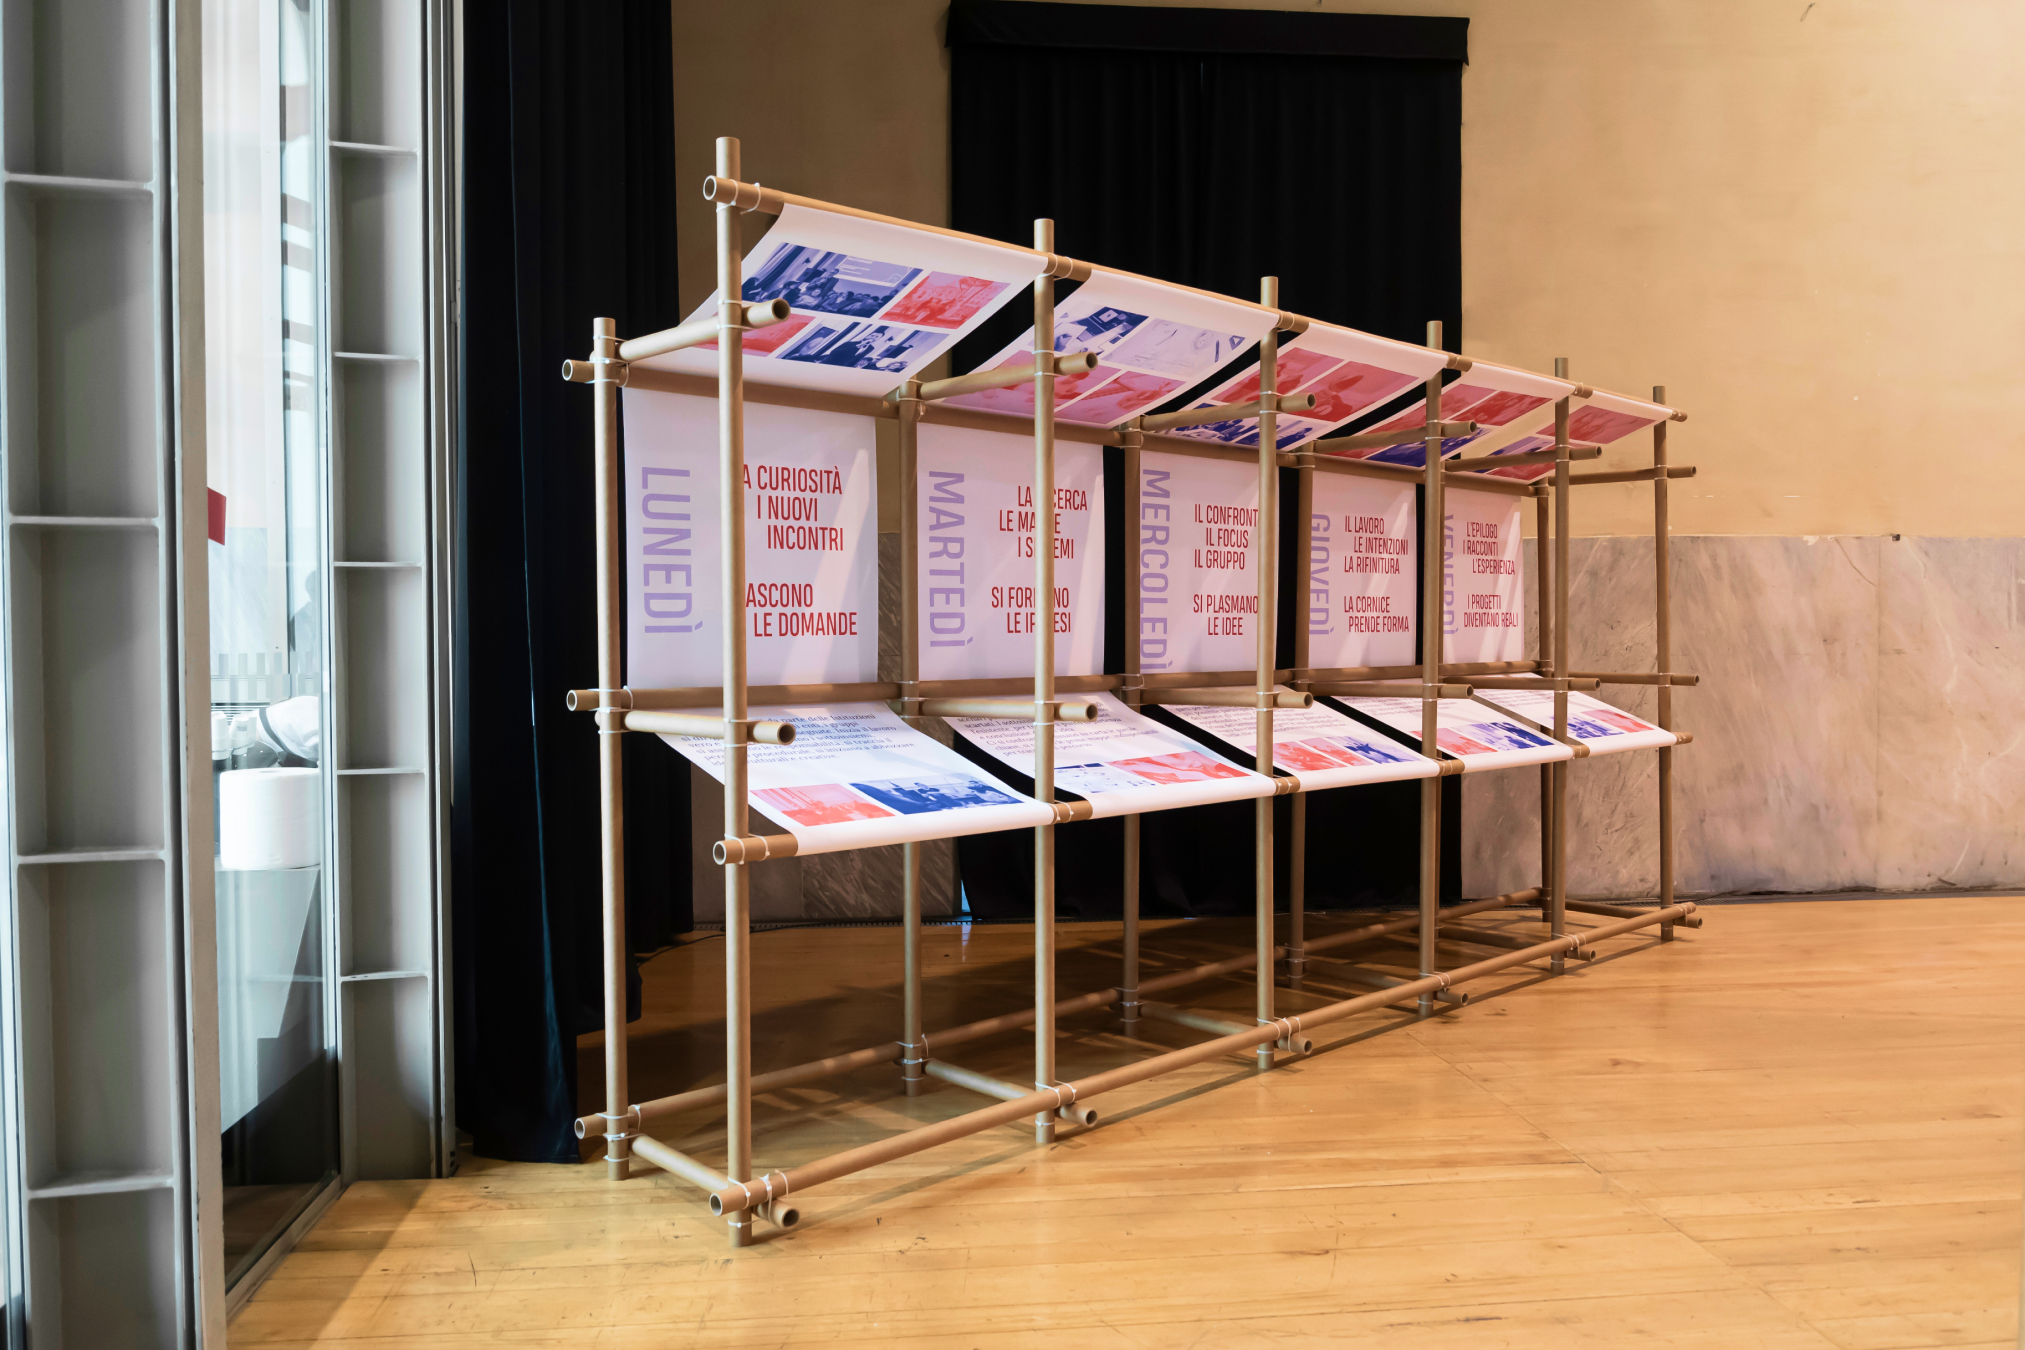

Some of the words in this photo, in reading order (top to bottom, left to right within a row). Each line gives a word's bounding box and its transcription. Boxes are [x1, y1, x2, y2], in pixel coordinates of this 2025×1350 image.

[744, 464, 752, 490] A
[758, 465, 842, 495] CURIOSITÀ
[757, 494, 761, 519] I
[768, 495, 818, 522] NUOVI
[1018, 486, 1032, 508] LA
[1000, 510, 1014, 532] LE
[1018, 511, 1061, 534] MAE
[1194, 504, 1203, 524] IL
[1206, 505, 1258, 528] CONFRONT
[1345, 515, 1352, 533] IL
[1354, 516, 1384, 535] LAVORO
[767, 525, 844, 551] INCONTRI
[1206, 528, 1214, 547] IL
[1218, 529, 1248, 548] FOCUS
[1466, 522, 1498, 539] L'EPILOGO
[642, 466, 703, 634] LUNEDÌ
[1018, 536, 1022, 558] I
[1354, 536, 1363, 553] LE
[1366, 538, 1408, 556] INTENZIONI
[1462, 540, 1465, 554] I
[1467, 540, 1498, 557] RACCONTI
[928, 470, 974, 648] MARTEDÌ
[1140, 469, 1173, 670] MERCOLEDÌ
[1194, 550, 1203, 568] IL
[1206, 550, 1245, 570] GRUPPO
[1344, 556, 1354, 573] LA
[1356, 557, 1400, 575] RIFINITURA
[1472, 558, 1515, 575] L'ESPERIENZA
[1309, 514, 1334, 635] GIOVEDÌ
[746, 582, 814, 608] ASCONO
[991, 586, 1004, 608] SI
[1194, 594, 1203, 614] SI
[1206, 595, 1258, 614] PLASMANO
[1344, 596, 1354, 612] LA
[1356, 596, 1390, 613] CORNICE
[1468, 594, 1470, 609] I
[1471, 594, 1501, 610] PROGETTI
[754, 612, 772, 637] LE
[778, 612, 858, 637] DOMANDE
[1007, 612, 1021, 634] LE
[1208, 617, 1218, 636] LE
[1222, 617, 1243, 636] IDEE
[1348, 616, 1380, 632] PRENDE
[1382, 616, 1409, 632] FORMA
[1464, 613, 1499, 628] DIVENTANO
[1502, 613, 1518, 628] REALI
